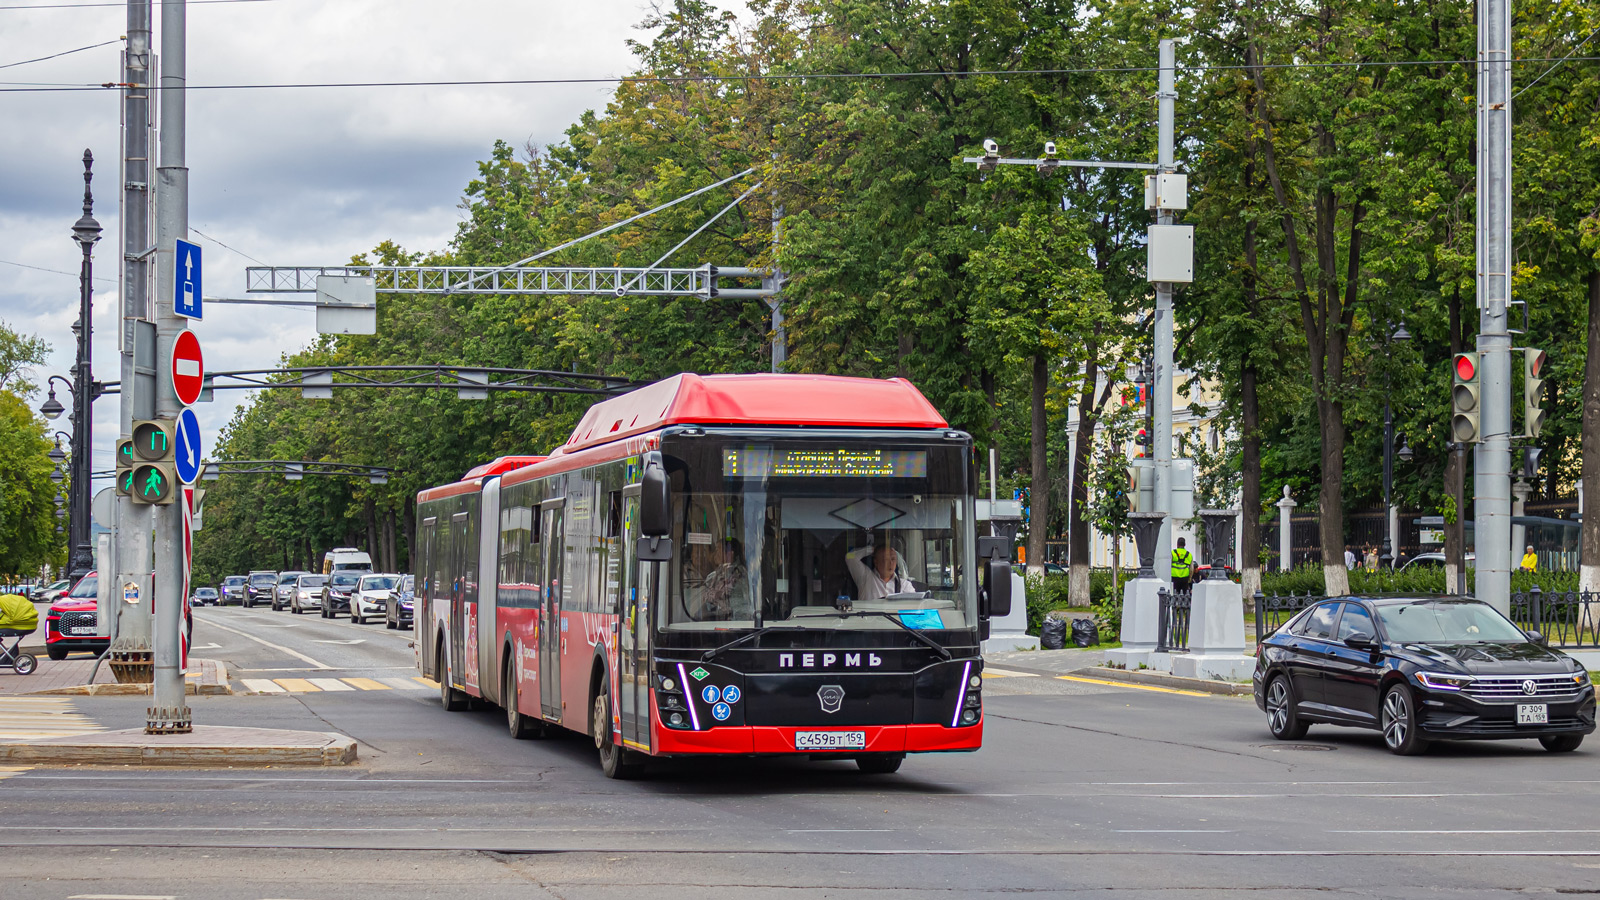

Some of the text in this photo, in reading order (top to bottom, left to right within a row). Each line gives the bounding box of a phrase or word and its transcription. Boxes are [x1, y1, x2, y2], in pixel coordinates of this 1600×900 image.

[151, 431, 166, 451] 17
[779, 653, 882, 668] ПЕРМЬ
[799, 733, 862, 746] С459ВТ 159
